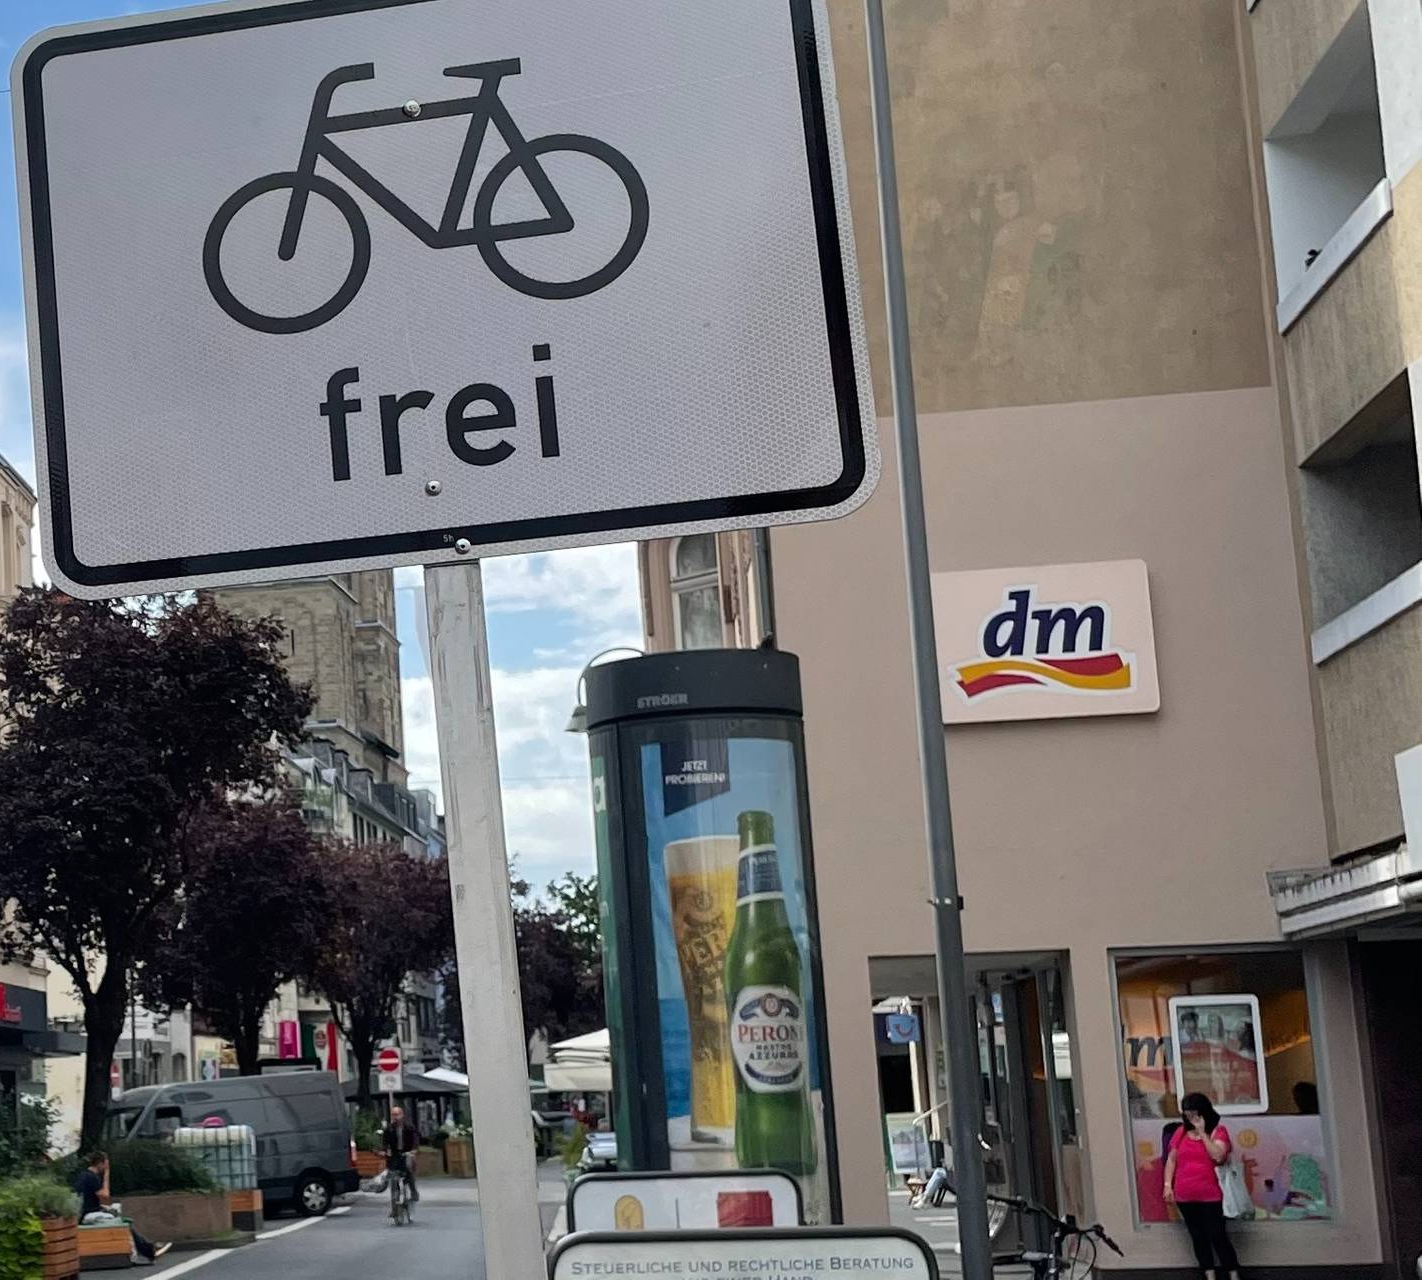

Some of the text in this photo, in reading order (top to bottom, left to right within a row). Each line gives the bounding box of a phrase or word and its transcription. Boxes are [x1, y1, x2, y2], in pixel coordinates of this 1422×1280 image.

[319, 344, 560, 482] frei
[983, 590, 1105, 658] dm
[682, 760, 708, 772] JETZT
[571, 1256, 914, 1275] STEUERLICHE UND RECHTLICHE BERATUNG
